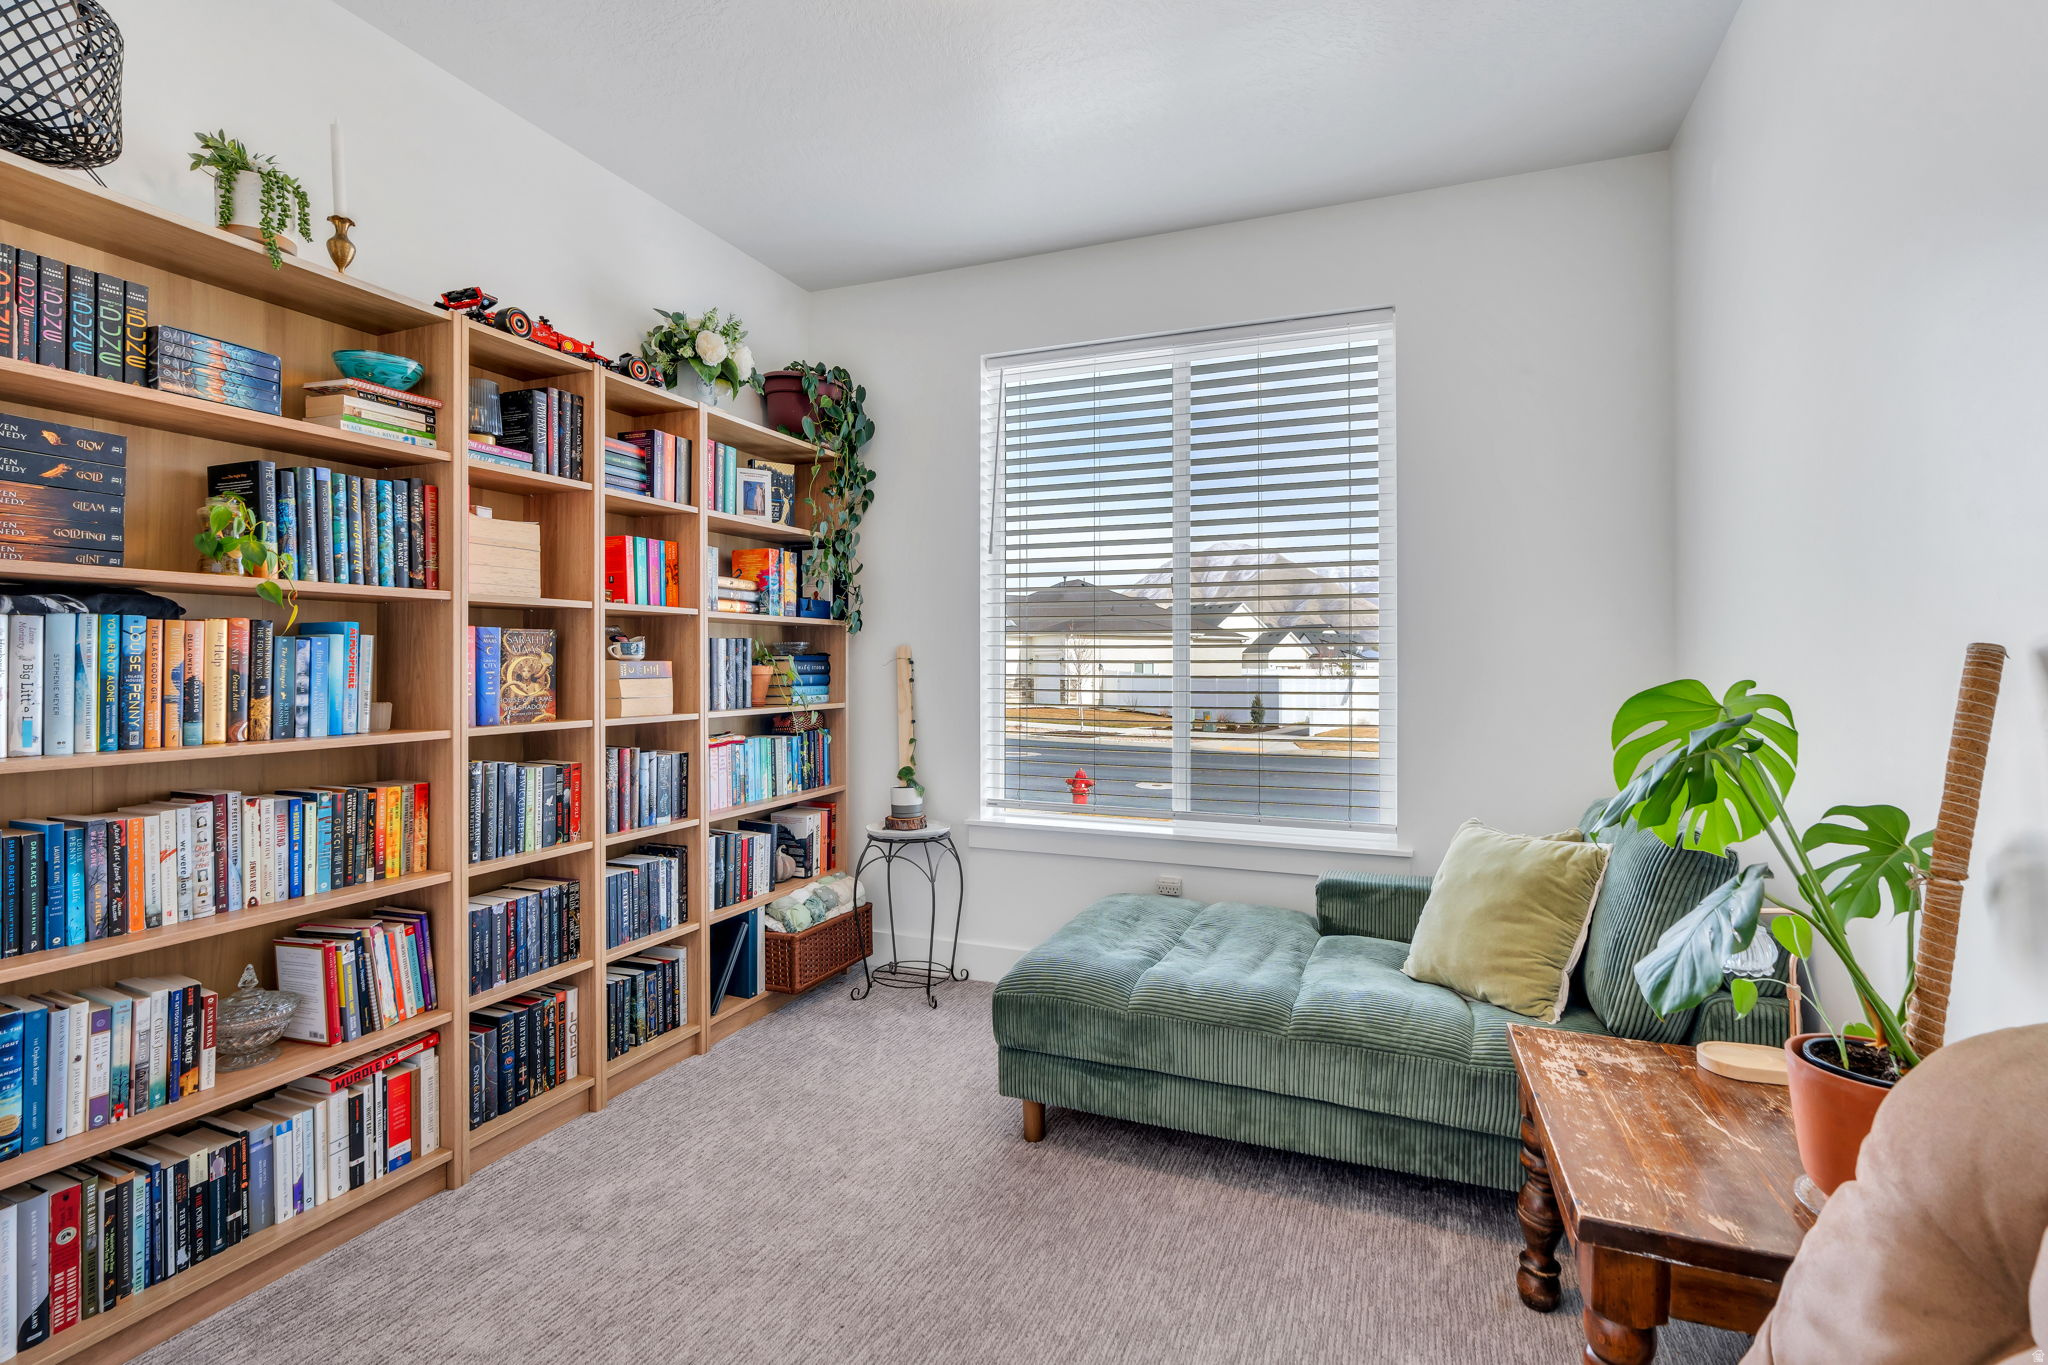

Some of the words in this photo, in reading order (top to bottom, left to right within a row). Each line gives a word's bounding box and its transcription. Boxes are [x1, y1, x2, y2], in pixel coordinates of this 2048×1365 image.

[18, 276, 34, 317] DUNE
[99, 286, 122, 296] HERBERT
[102, 282, 120, 290] FRANK
[43, 289, 63, 342] DUNE
[72, 300, 93, 355] DUNE
[99, 305, 122, 367] DUNE
[126, 313, 147, 369] DUNE
[537, 402, 546, 444] POWERLESS
[76, 439, 104, 451] GLOW
[75, 471, 103, 482] GOLD
[72, 501, 105, 512] GLEAM
[53, 528, 106, 542] GOLDFINCH
[75, 554, 104, 564] GLINT
[17, 621, 27, 650] Moriarty
[107, 618, 115, 635] YOU
[107, 640, 115, 653] ARE
[130, 625, 143, 672] LOUISE
[211, 644, 224, 667] Help
[348, 628, 356, 688] ATMOSPHERE
[512, 645, 541, 653] MAAS
[20, 664, 33, 680] Big
[107, 656, 115, 673] NOT
[107, 675, 115, 702] ALONE
[129, 684, 140, 726] PENNY
[216, 820, 224, 852] WIVES
[276, 814, 286, 847] BOYFRIEND
[180, 878, 189, 896] liars
[154, 1017, 164, 1044] Cilka's
[502, 1022, 510, 1054] KING
[0, 1068, 22, 1076] ANNOT
[152, 1045, 163, 1076] Journey
[336, 1062, 381, 1089] MURDLE
[72, 1091, 81, 1114] dugard
[87, 1184, 96, 1206] BENNIE
[87, 1213, 96, 1235] ADKINS
